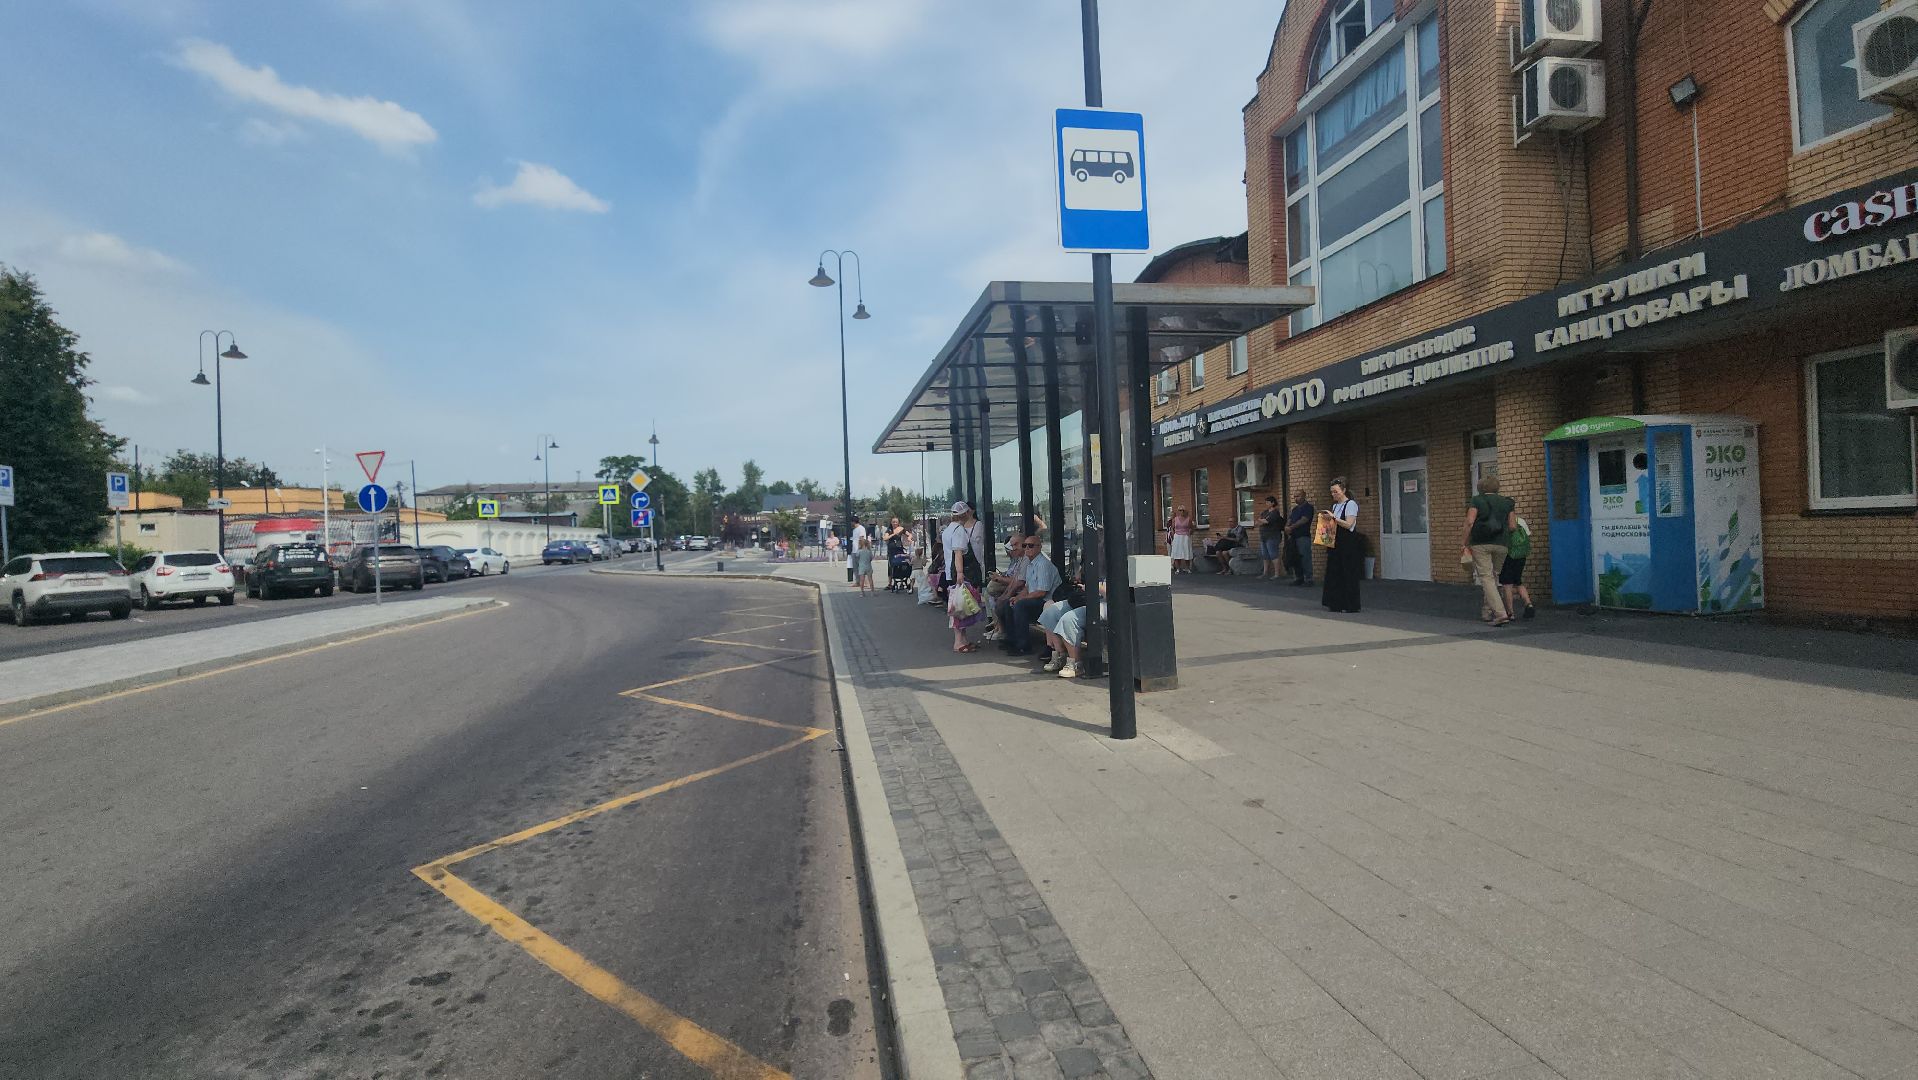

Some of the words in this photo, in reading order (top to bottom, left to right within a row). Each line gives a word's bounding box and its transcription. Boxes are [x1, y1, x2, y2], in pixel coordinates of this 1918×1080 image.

[1557, 252, 1706, 318] ИГРУШКИ
[1534, 274, 1749, 352] КАНЦТОВАРЫ
[1360, 351, 1395, 376] БЮРО
[1395, 325, 1476, 366] ПЕРЕВОДОВ
[1332, 368, 1413, 405] ОФОРМЛЕНИЕ
[1413, 340, 1515, 387] ДОКУМЕНТОВ
[1261, 377, 1325, 419] ФОТО
[1163, 429, 1195, 448] БИЛЕТЫ
[1565, 423, 1589, 436] ЭКО
[1705, 445, 1746, 464] ЭКО
[1705, 466, 1747, 481] пункт
[1602, 495, 1624, 504] ЭКО
